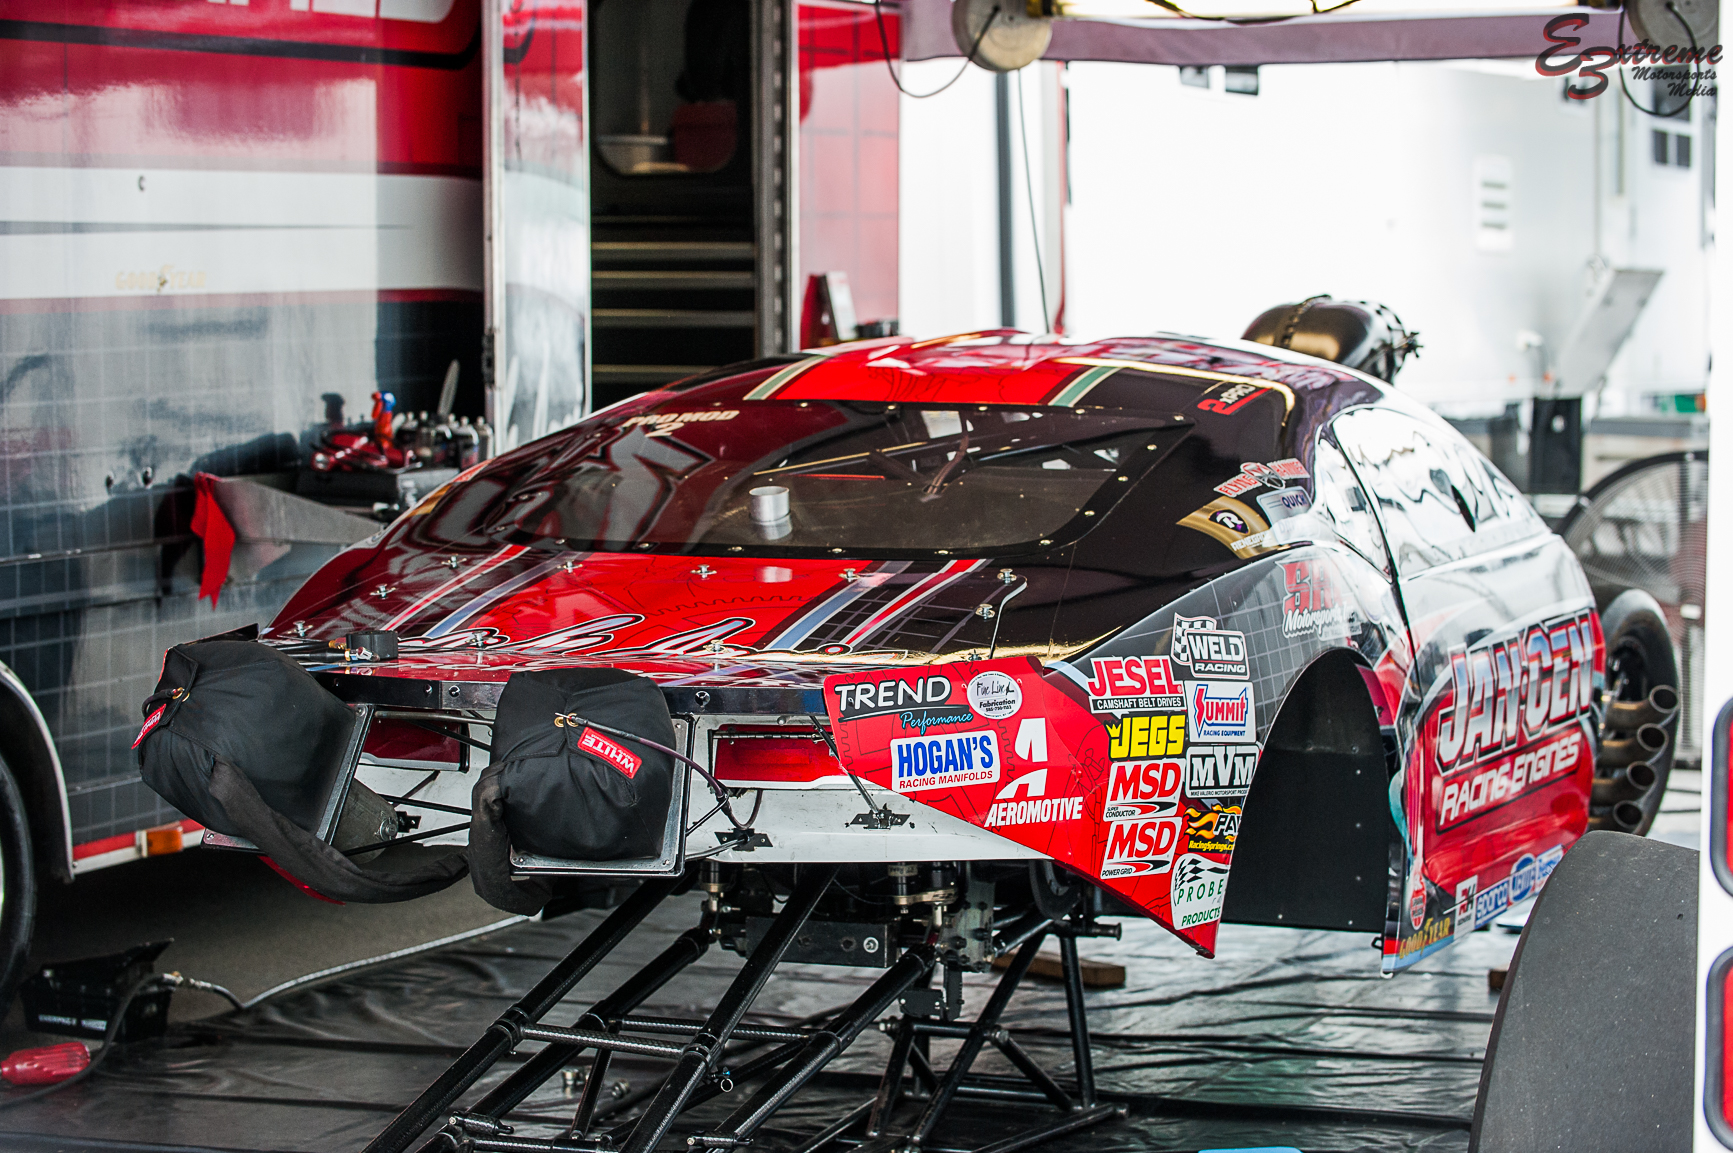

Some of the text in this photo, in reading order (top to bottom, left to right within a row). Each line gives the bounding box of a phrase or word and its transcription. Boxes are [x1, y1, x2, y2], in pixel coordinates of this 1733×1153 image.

[621, 410, 740, 428] PRO MOD
[645, 422, 685, 437] 2
[1188, 635, 1245, 662] WELD
[1087, 658, 1184, 697] JESEL
[1195, 662, 1246, 673] RACING
[834, 676, 952, 712] TREND
[979, 698, 1016, 709] Fabrication
[1097, 697, 1182, 710] CAMSHAFT BELT DRIVES
[900, 711, 974, 736] Performance
[1110, 714, 1186, 759] JEGS
[1203, 729, 1246, 737] RACING EQUIPMENT
[581, 734, 635, 774] WHITE
[897, 734, 994, 779] HOGAN'S
[1190, 745, 1255, 787] MVM
[1510, 732, 1582, 795] ENGINES
[899, 770, 994, 790] RACING MANIFOLDS
[1109, 762, 1182, 802] MSD
[1440, 763, 1511, 826] RACING
[983, 796, 1084, 828] AEROMOTIVE
[1105, 809, 1136, 818] CONDUCTOR
[1106, 821, 1177, 860] MSD
[1101, 867, 1133, 877] POWER GRID
[1176, 878, 1225, 905] PROBE
[1181, 906, 1221, 927] PRODUCTS
